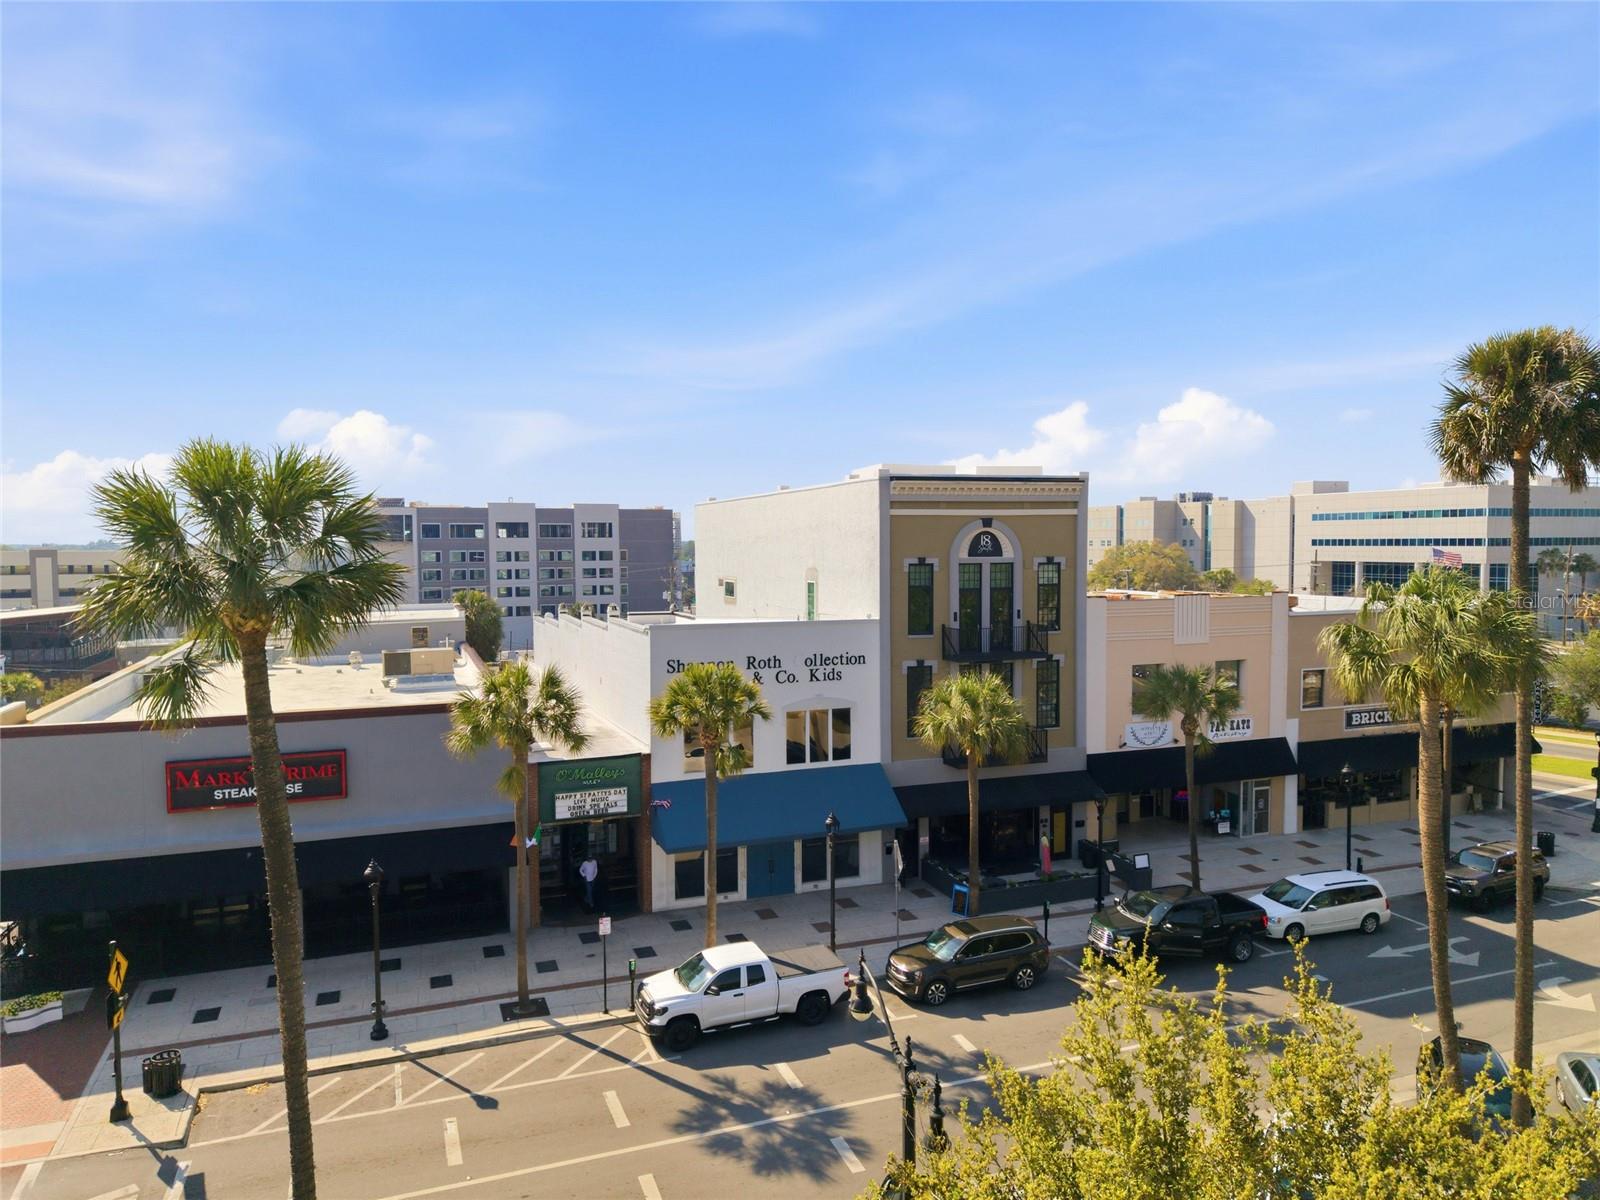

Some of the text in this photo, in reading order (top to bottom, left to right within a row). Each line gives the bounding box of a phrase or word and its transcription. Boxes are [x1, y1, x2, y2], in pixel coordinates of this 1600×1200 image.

[746, 656, 782, 670] Roth
[752, 668, 842, 685] & Co. Kids
[1351, 711, 1393, 725] BRICK
[175, 766, 256, 789] MARK'
[214, 782, 303, 800] STEAKSE
[567, 804, 586, 812] DRINK
